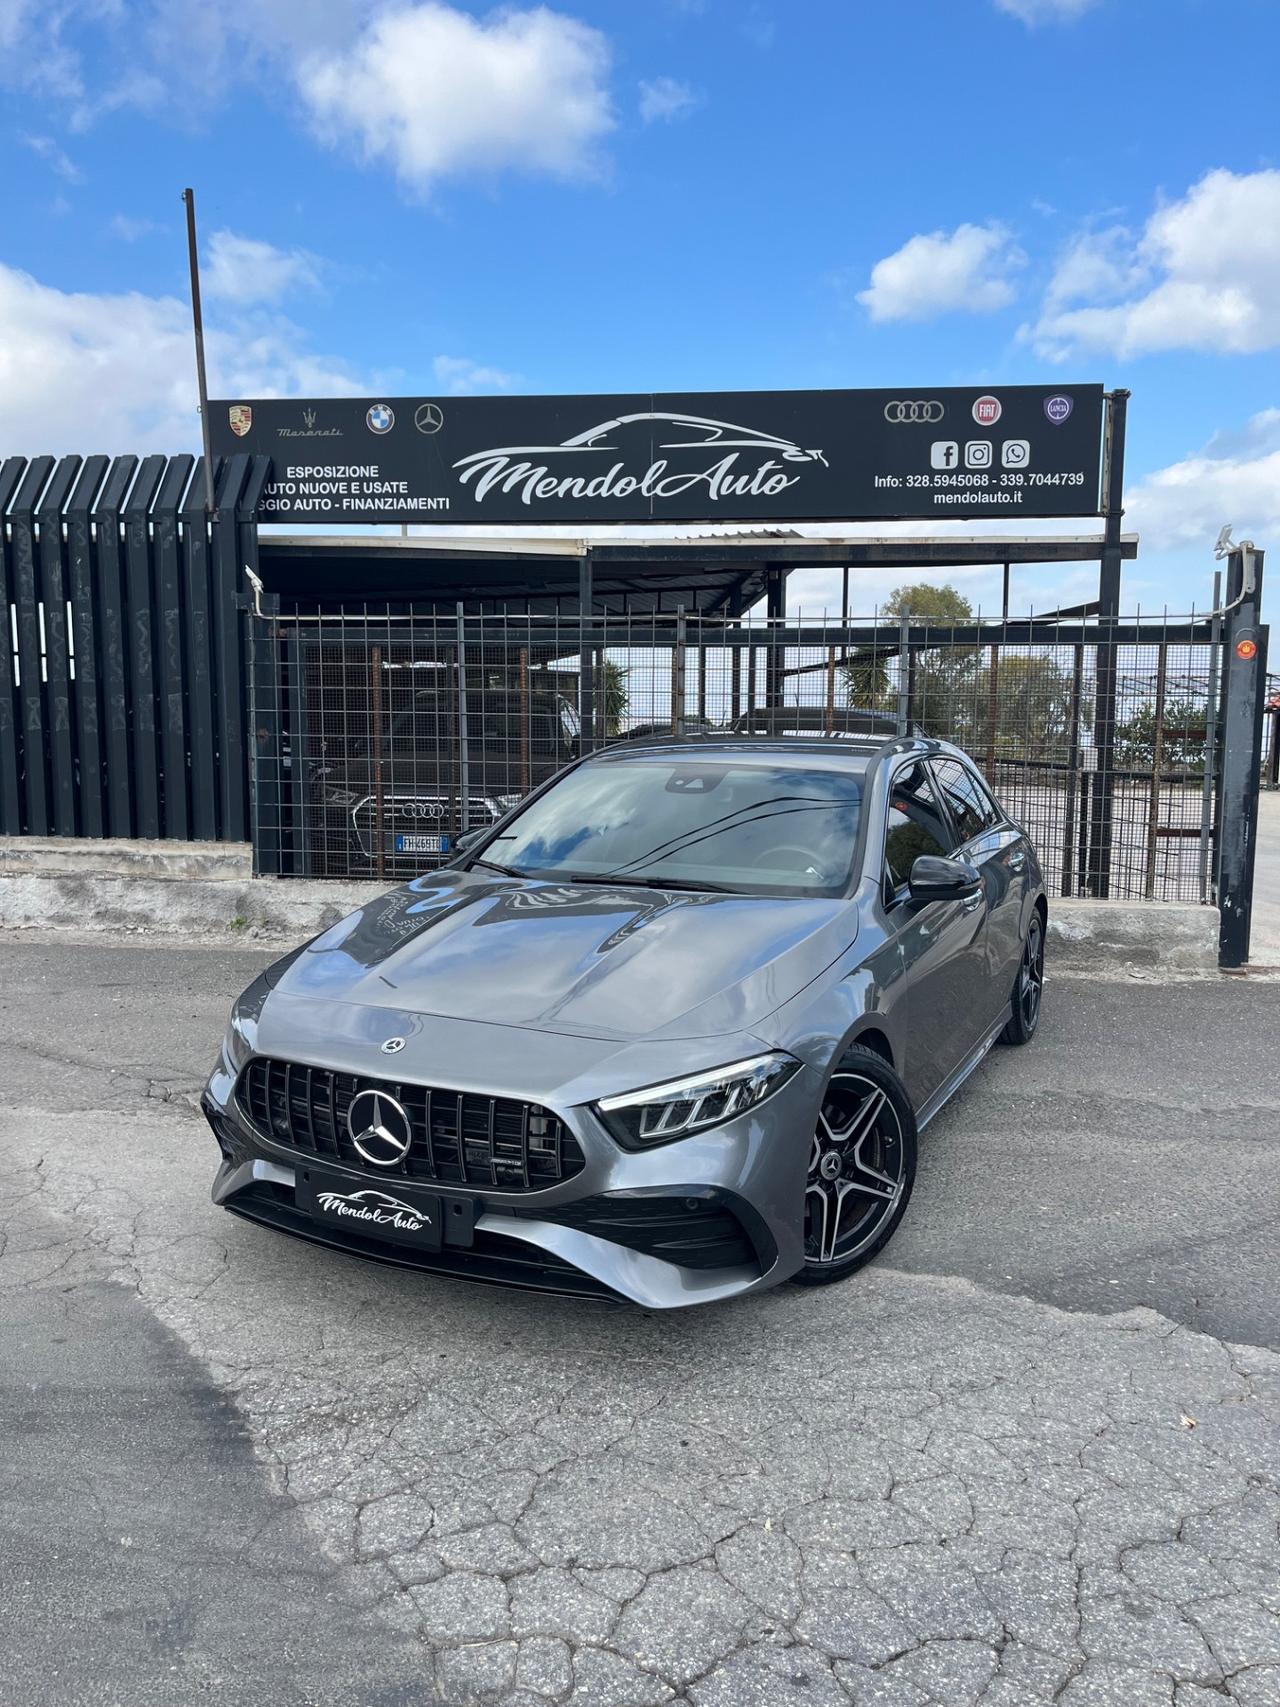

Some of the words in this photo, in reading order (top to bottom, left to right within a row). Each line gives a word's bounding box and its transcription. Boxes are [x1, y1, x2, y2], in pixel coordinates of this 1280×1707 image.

[979, 403, 996, 418] FIAT
[276, 427, 345, 438] Maserati
[286, 465, 379, 479] ESPOSIZIONE
[874, 475, 902, 488] Info:
[906, 474, 989, 488] 328.5945068
[1000, 472, 1084, 487] 339.7044739
[264, 482, 296, 495] UTO
[299, 482, 348, 495] NUOVE
[351, 482, 360, 494] E
[363, 481, 408, 494] USATE
[293, 498, 332, 511] AUTO
[342, 497, 450, 511] FINANZIAMENTI
[933, 491, 1023, 504] mendolauto.it
